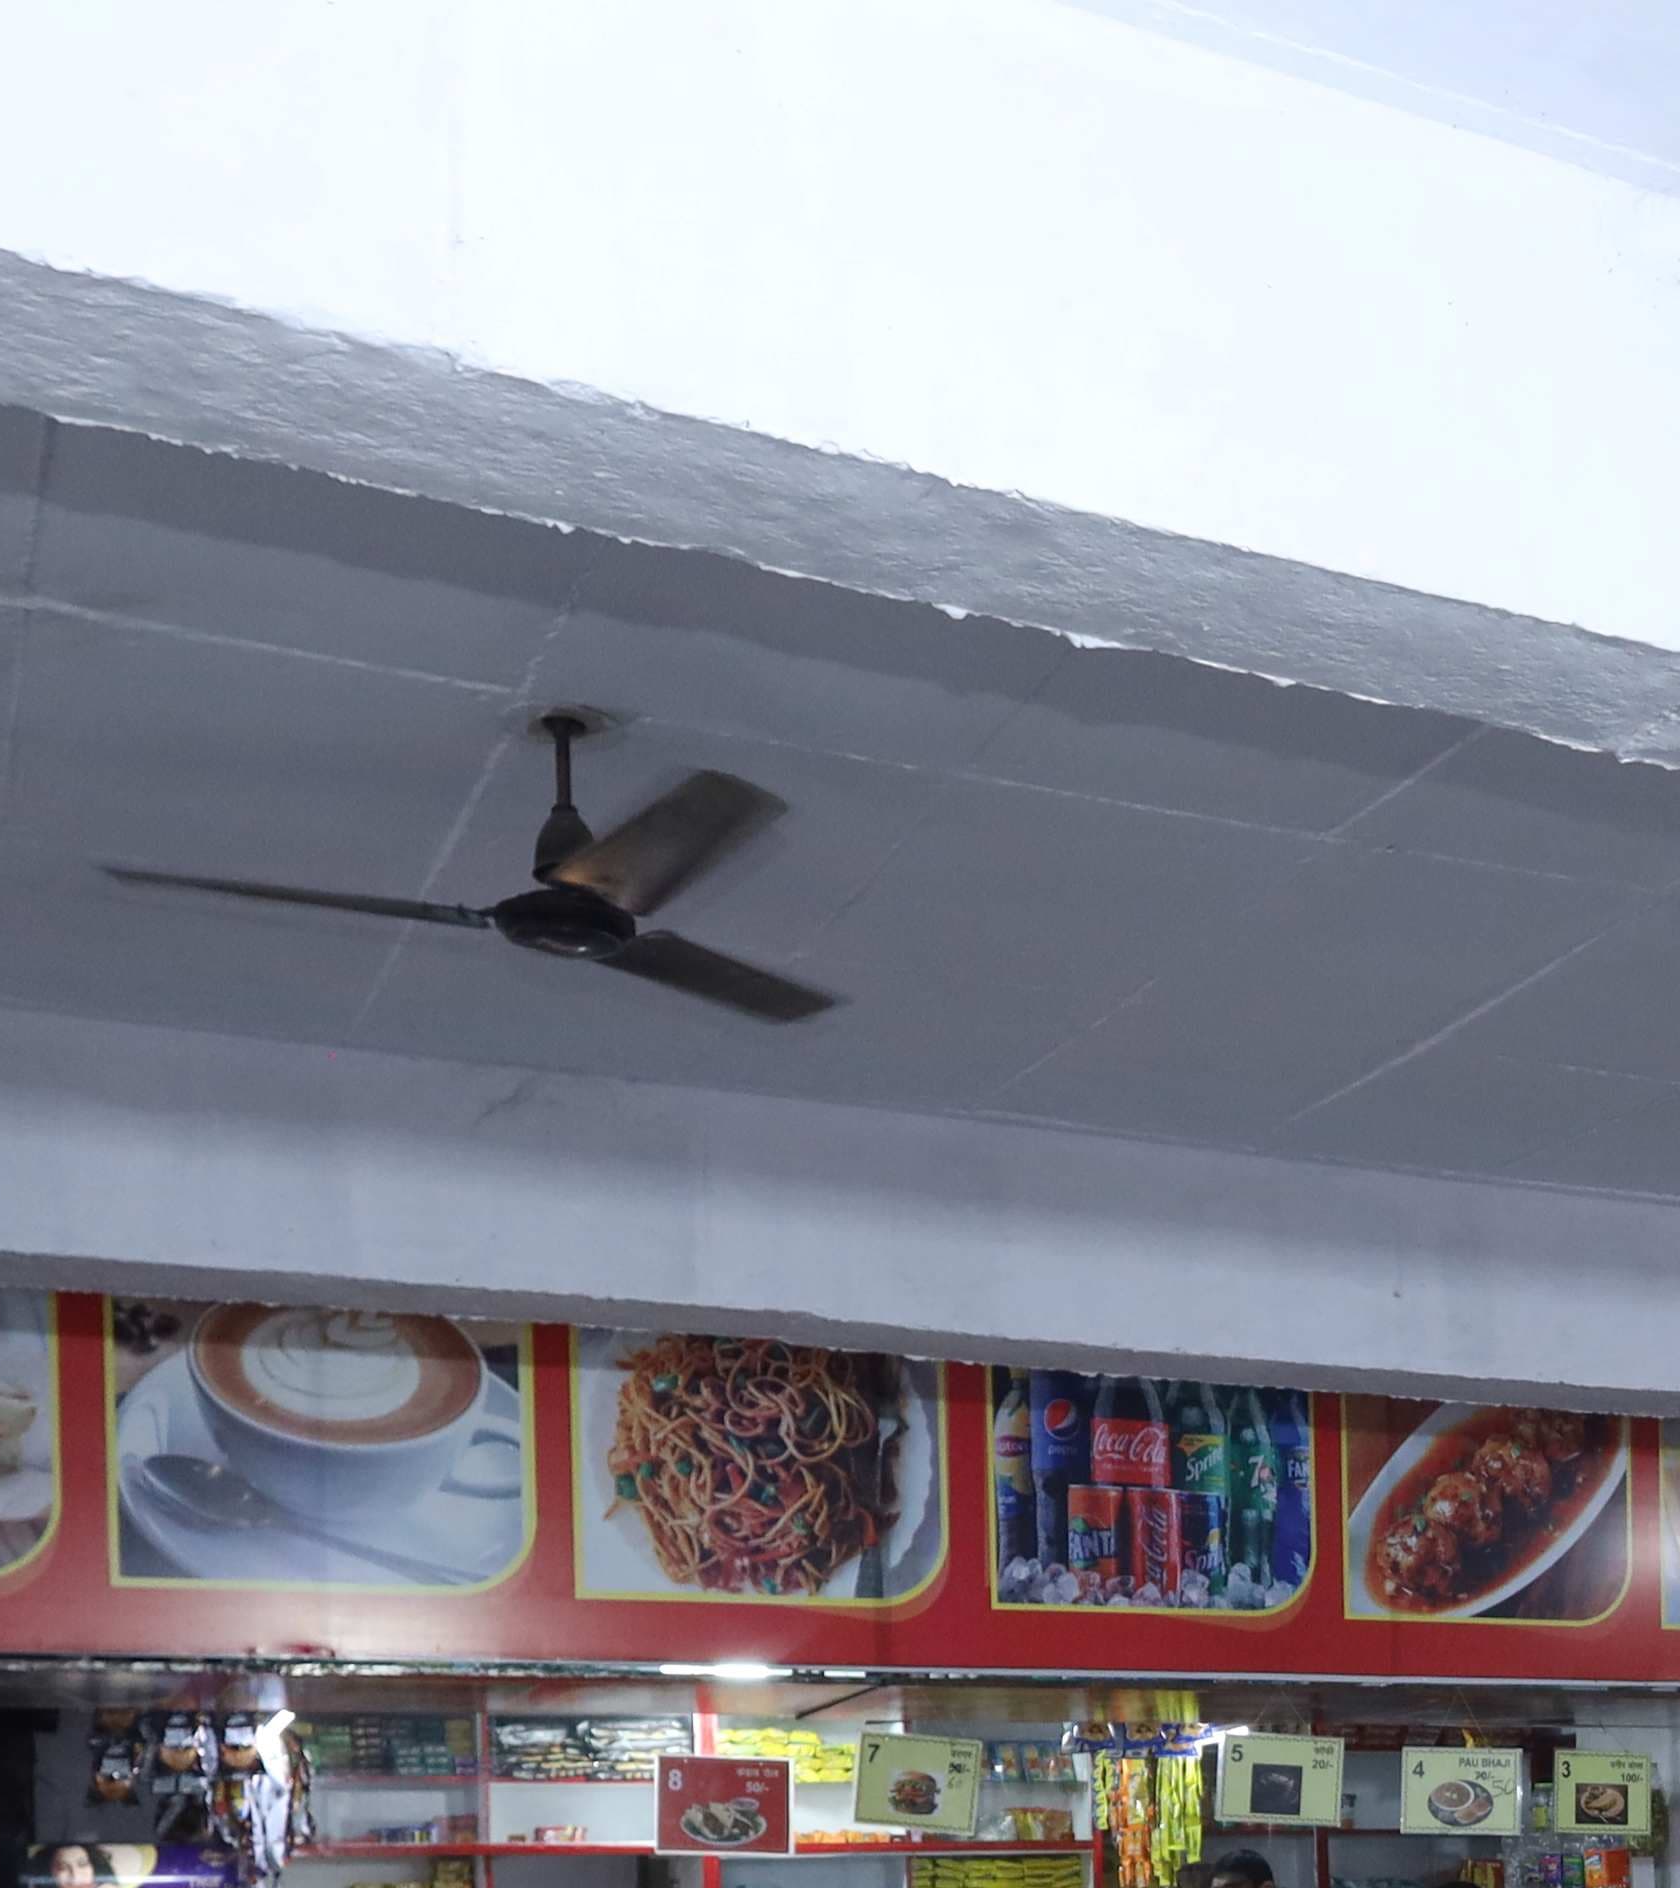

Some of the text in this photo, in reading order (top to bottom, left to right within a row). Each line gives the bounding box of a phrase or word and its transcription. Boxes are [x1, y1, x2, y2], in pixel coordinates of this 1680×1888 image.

[867, 1743, 881, 1763] 7
[1231, 1744, 1244, 1762] 5
[1312, 1759, 1334, 1770] 20/-
[1412, 1759, 1425, 1779] 4
[1458, 1757, 1511, 1768] PAU BHAJI
[1561, 1760, 1571, 1778] 3
[668, 1768, 683, 1791] 8
[1621, 1772, 1644, 1783] 100/-
